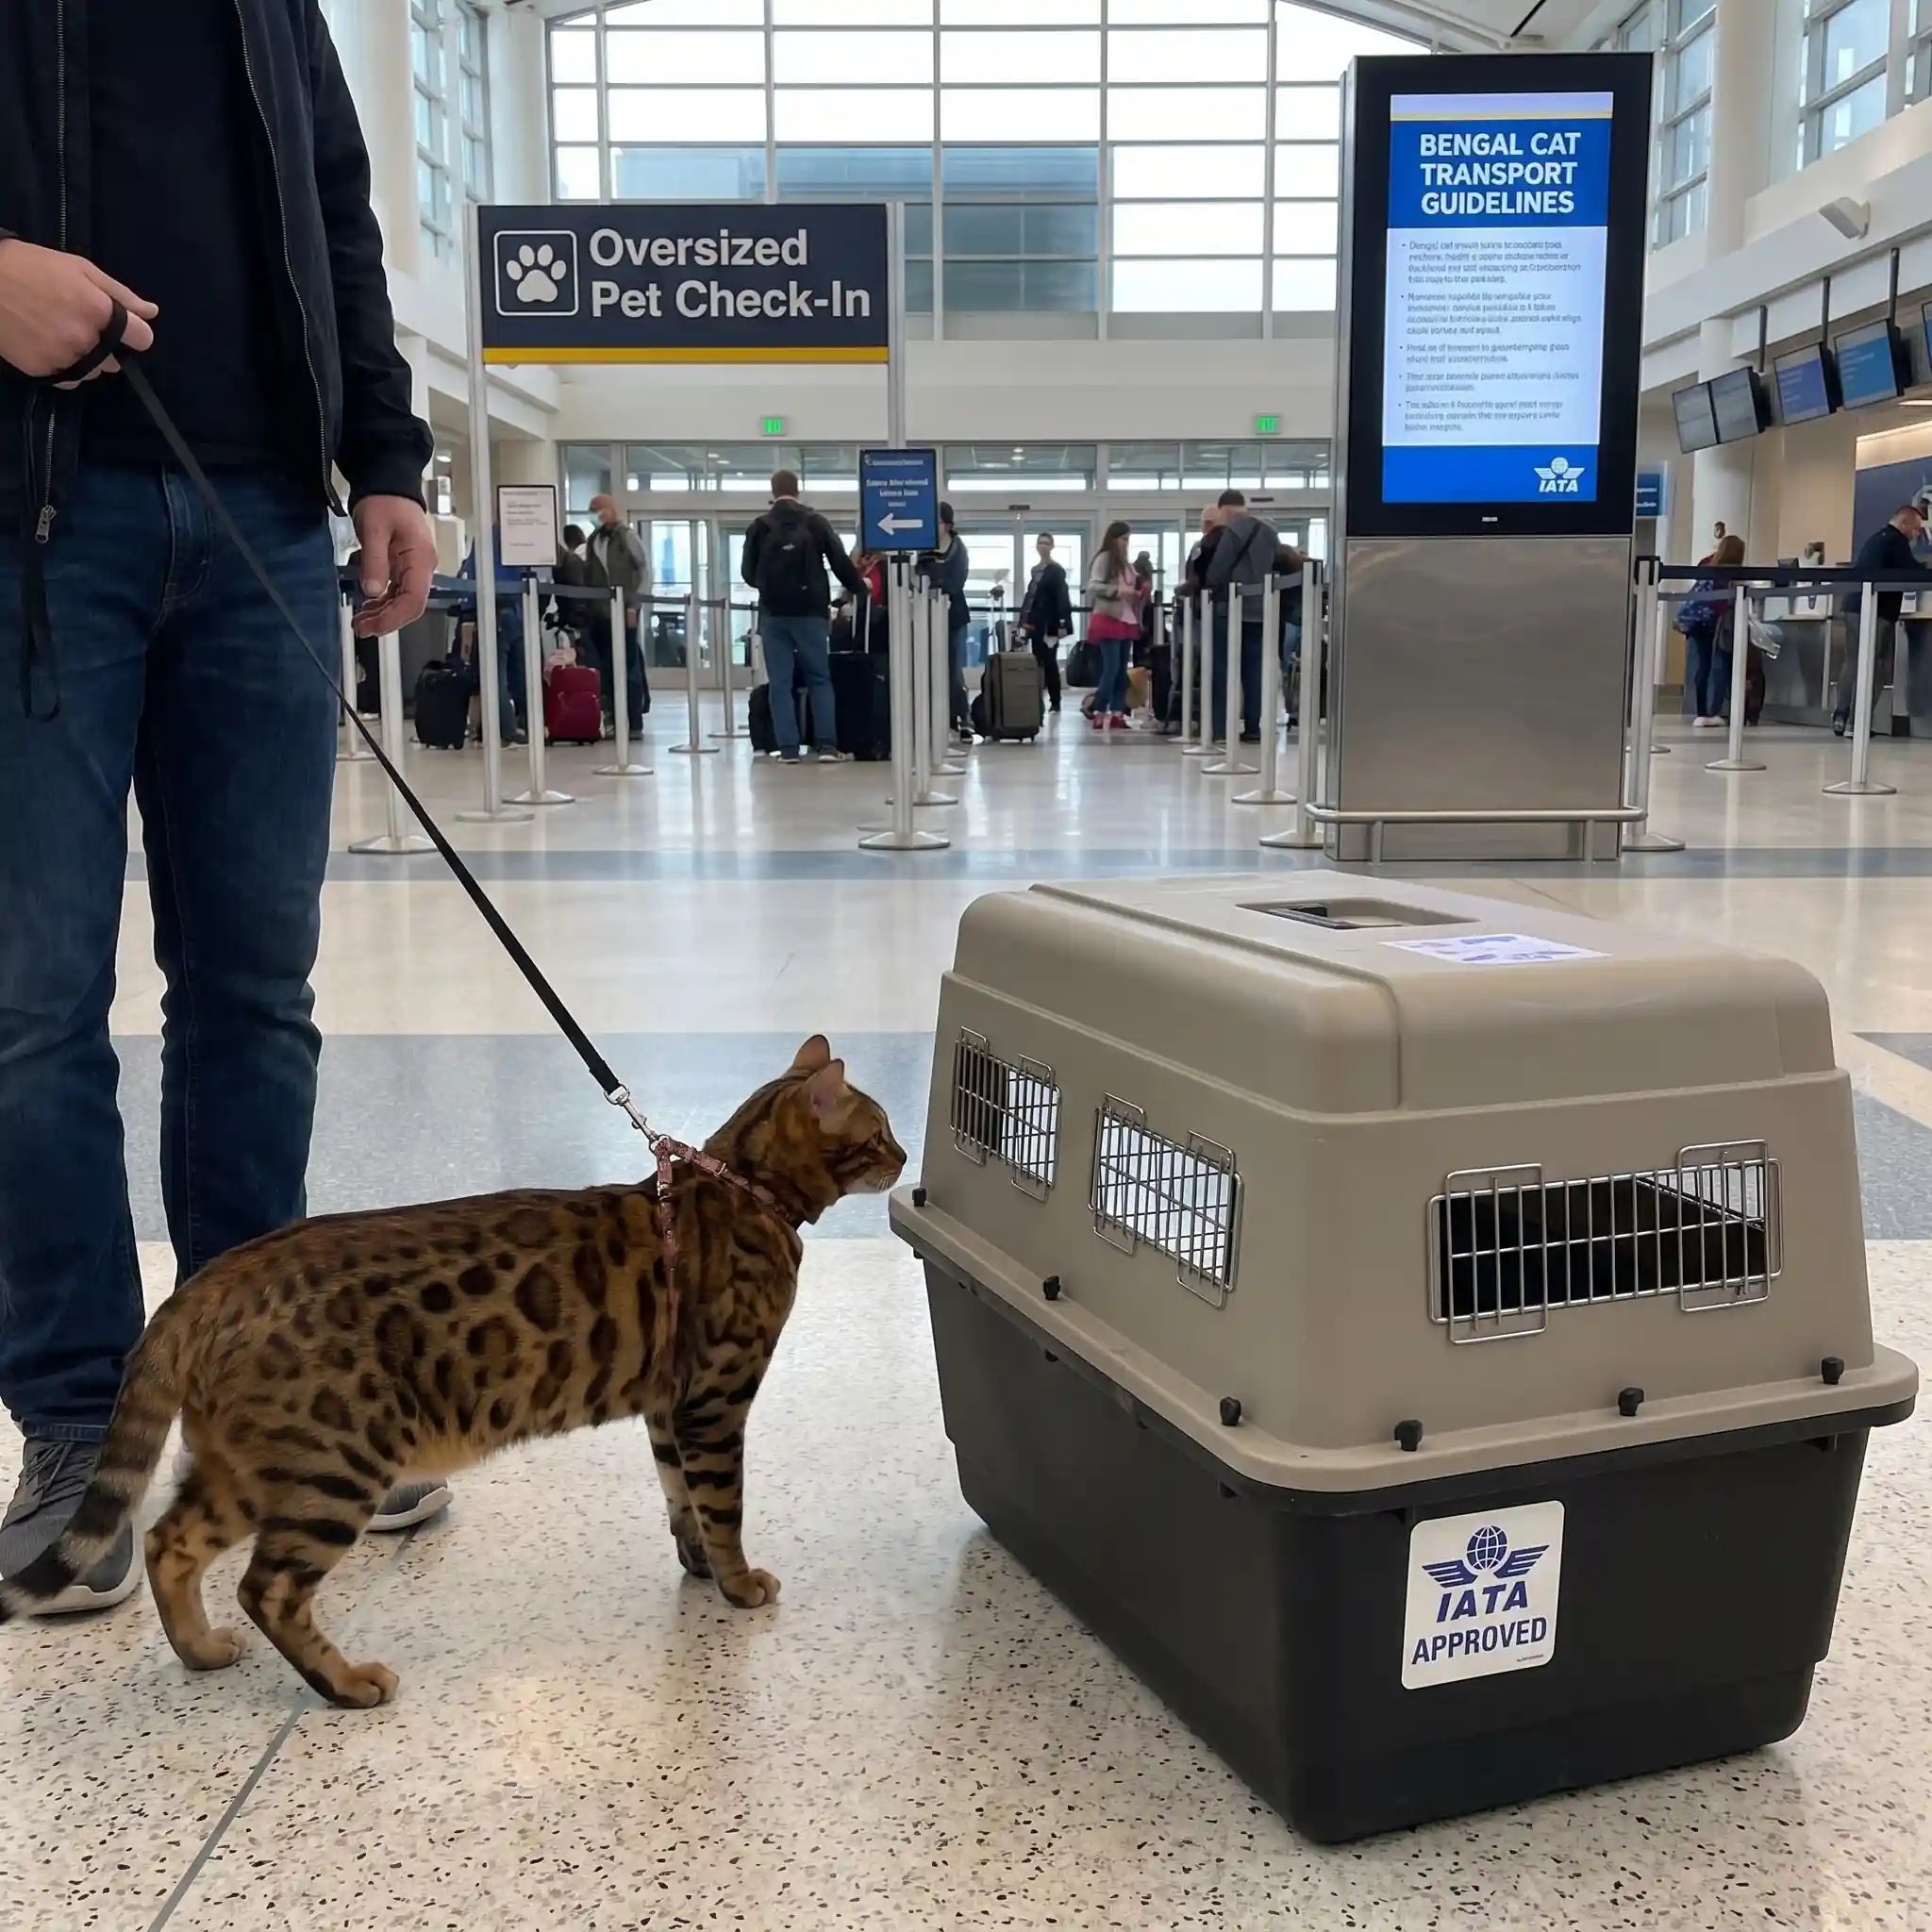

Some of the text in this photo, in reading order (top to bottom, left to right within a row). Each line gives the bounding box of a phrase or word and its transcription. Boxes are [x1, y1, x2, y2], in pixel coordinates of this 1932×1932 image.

[1420, 132, 1581, 157] BENGAL CAT
[1420, 161, 1578, 186] TRANSPORT
[1421, 191, 1574, 214] GUIDELINES
[589, 227, 808, 266] Oversized
[591, 279, 871, 318] Pet Check-In
[1539, 479, 1578, 492] IATA
[1436, 1580, 1528, 1623] IATA
[1411, 1616, 1547, 1665] APPROVED
